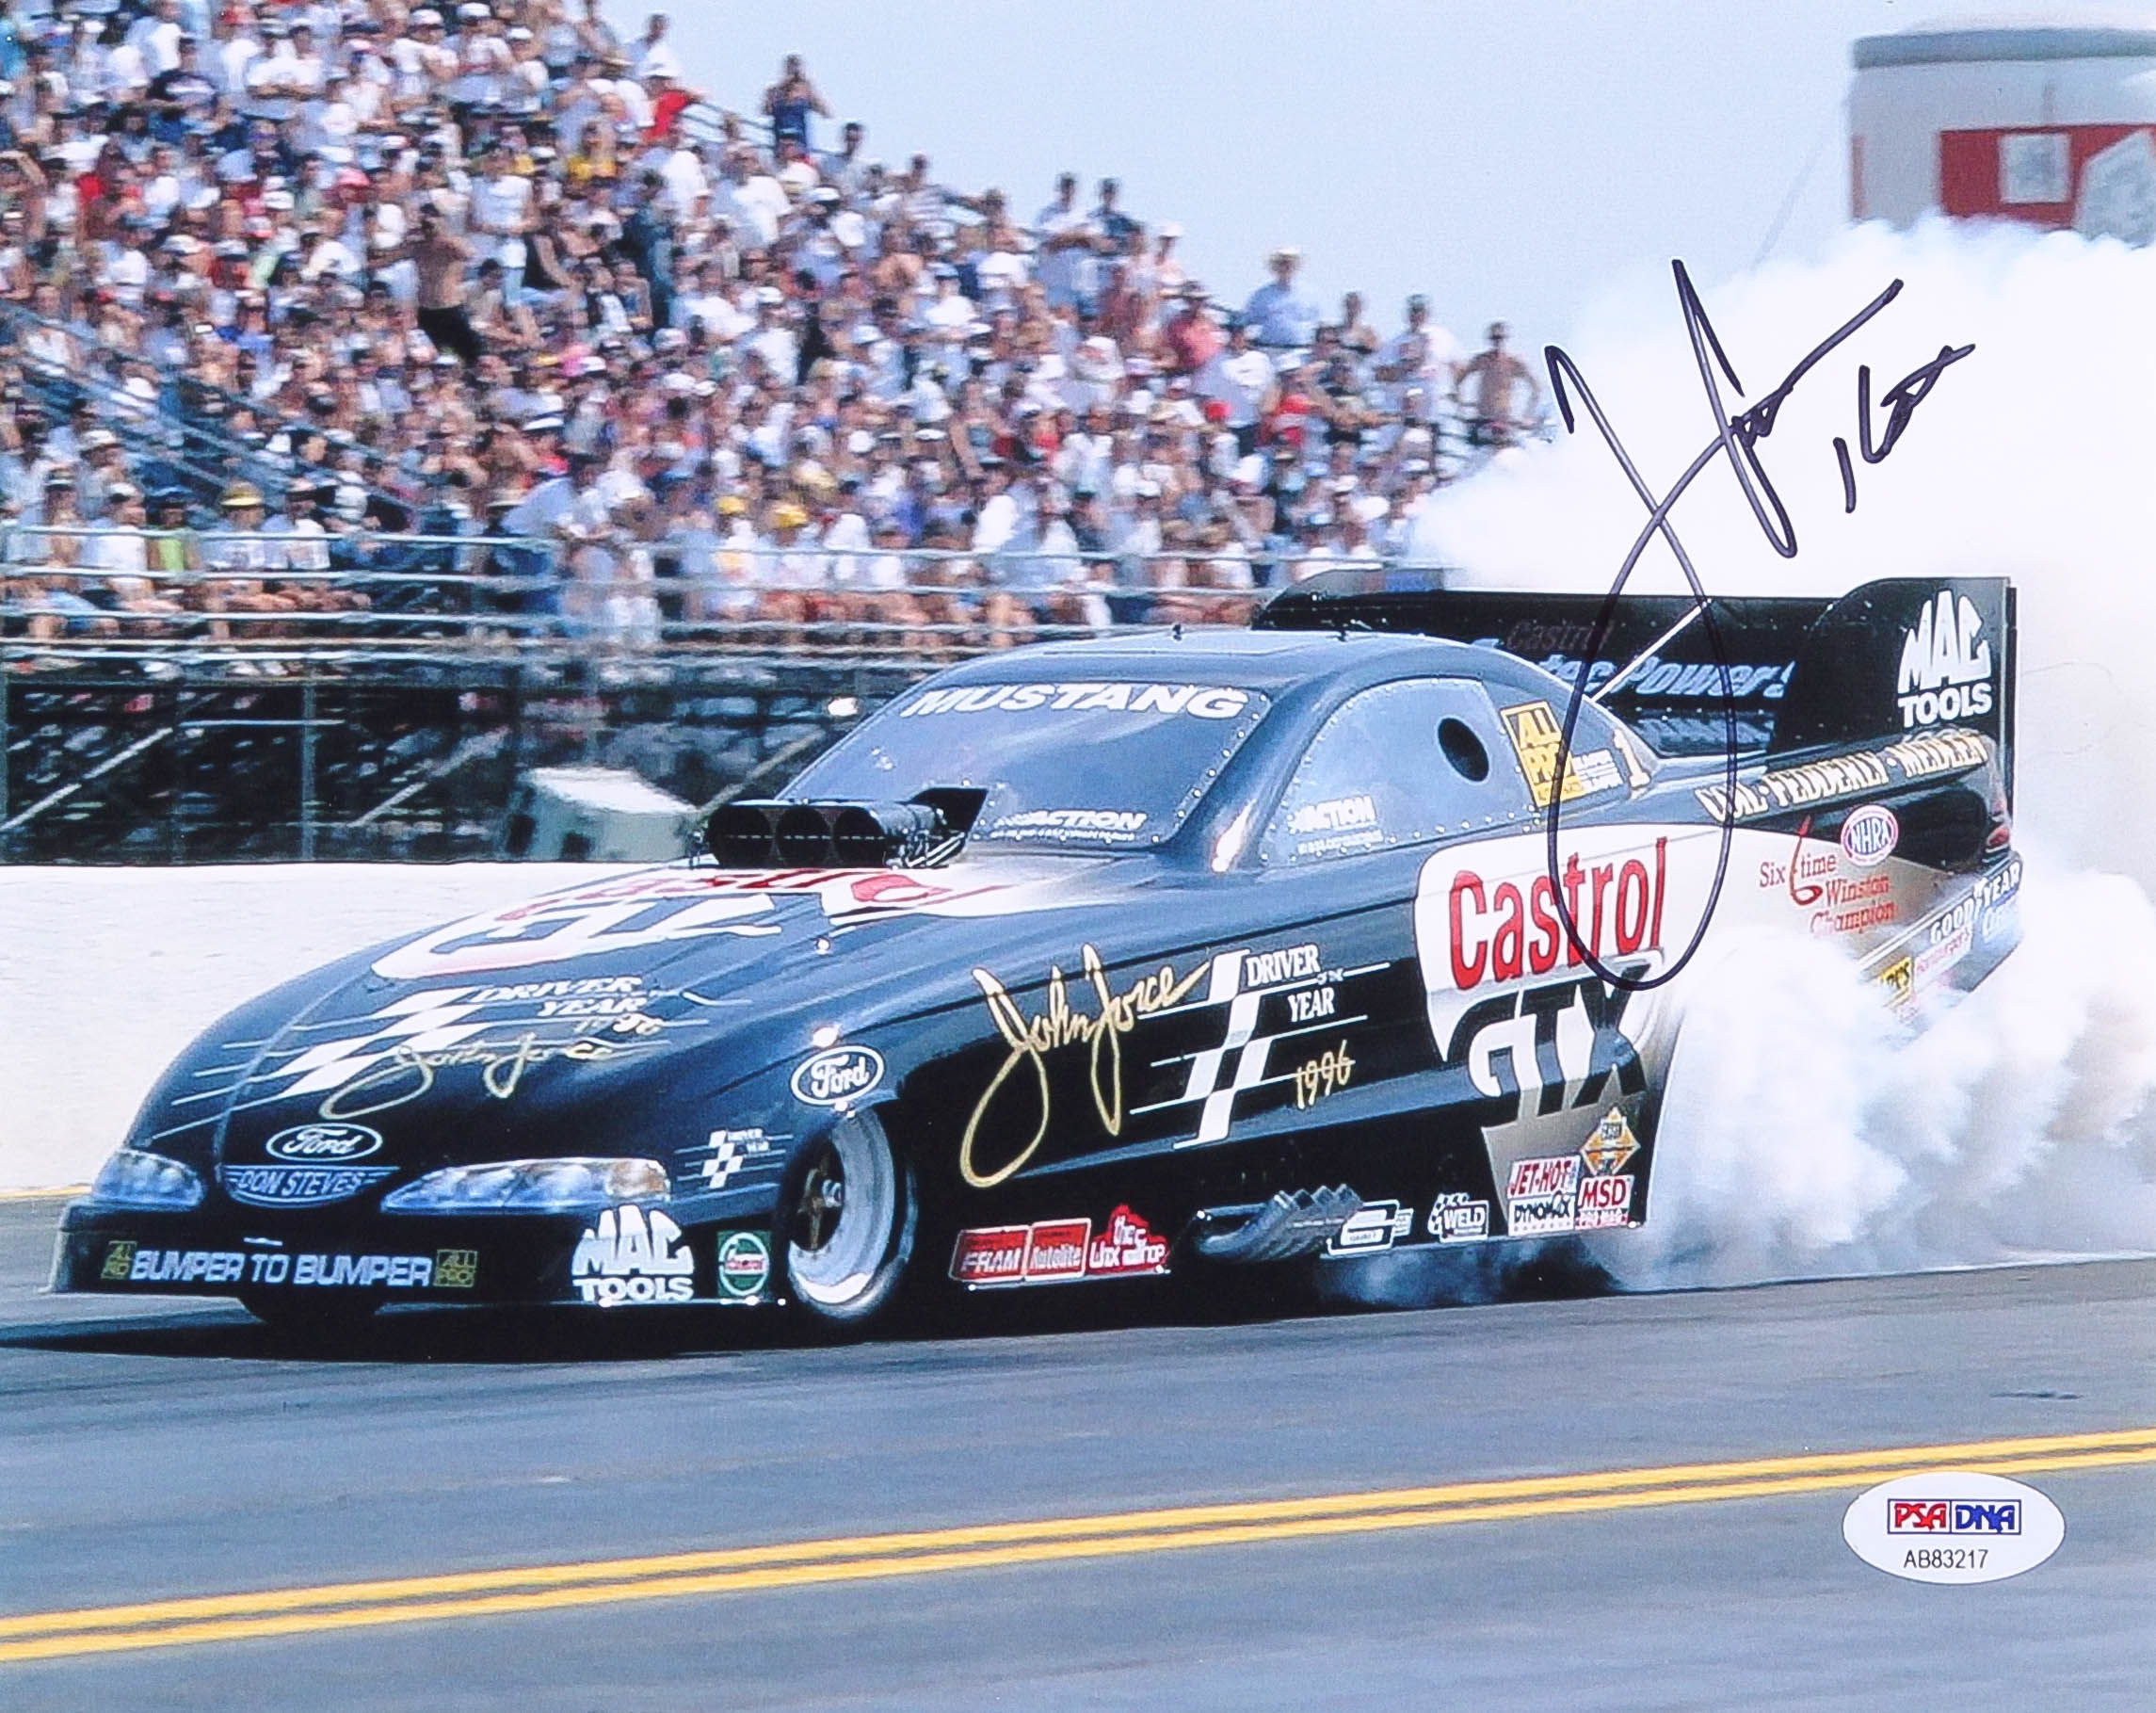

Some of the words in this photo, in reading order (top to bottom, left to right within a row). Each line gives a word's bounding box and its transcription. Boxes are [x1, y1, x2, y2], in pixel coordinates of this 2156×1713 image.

[1897, 590, 1991, 694] MAC
[899, 683, 1248, 719] MUSTANG
[1897, 683, 1992, 728] TOOLS
[1848, 821, 1891, 855] NHRA
[1759, 861, 1787, 888] Six
[1800, 853, 1836, 879] time
[1825, 874, 1891, 907] Winston
[1449, 836, 1668, 991] Castrol
[1810, 899, 1899, 935] Champion
[1246, 944, 1322, 987] DRIVER
[470, 976, 643, 1003] DRIVER
[538, 997, 649, 1017] YEAR
[1287, 986, 1335, 1023] YEAR
[1446, 961, 1654, 1125] GTX
[811, 1054, 870, 1099] Ford
[1295, 1039, 1356, 1109] 1996
[282, 1128, 363, 1155] Ford
[238, 1169, 283, 1195] DON
[282, 1171, 366, 1197] STEVES
[1578, 1178, 1628, 1210] MSD
[1442, 1206, 1487, 1231] WELD
[571, 1204, 695, 1275] MAC
[129, 1250, 246, 1282] BUMPER
[250, 1252, 290, 1284] TO
[293, 1254, 433, 1287] BUMPER
[961, 1246, 1022, 1273] FRAM
[572, 1277, 695, 1302] TOOLS
[1894, 1503, 1947, 1529] PSA
[1955, 1505, 2015, 1533] DNA
[1903, 1549, 1989, 1569] AB83217
